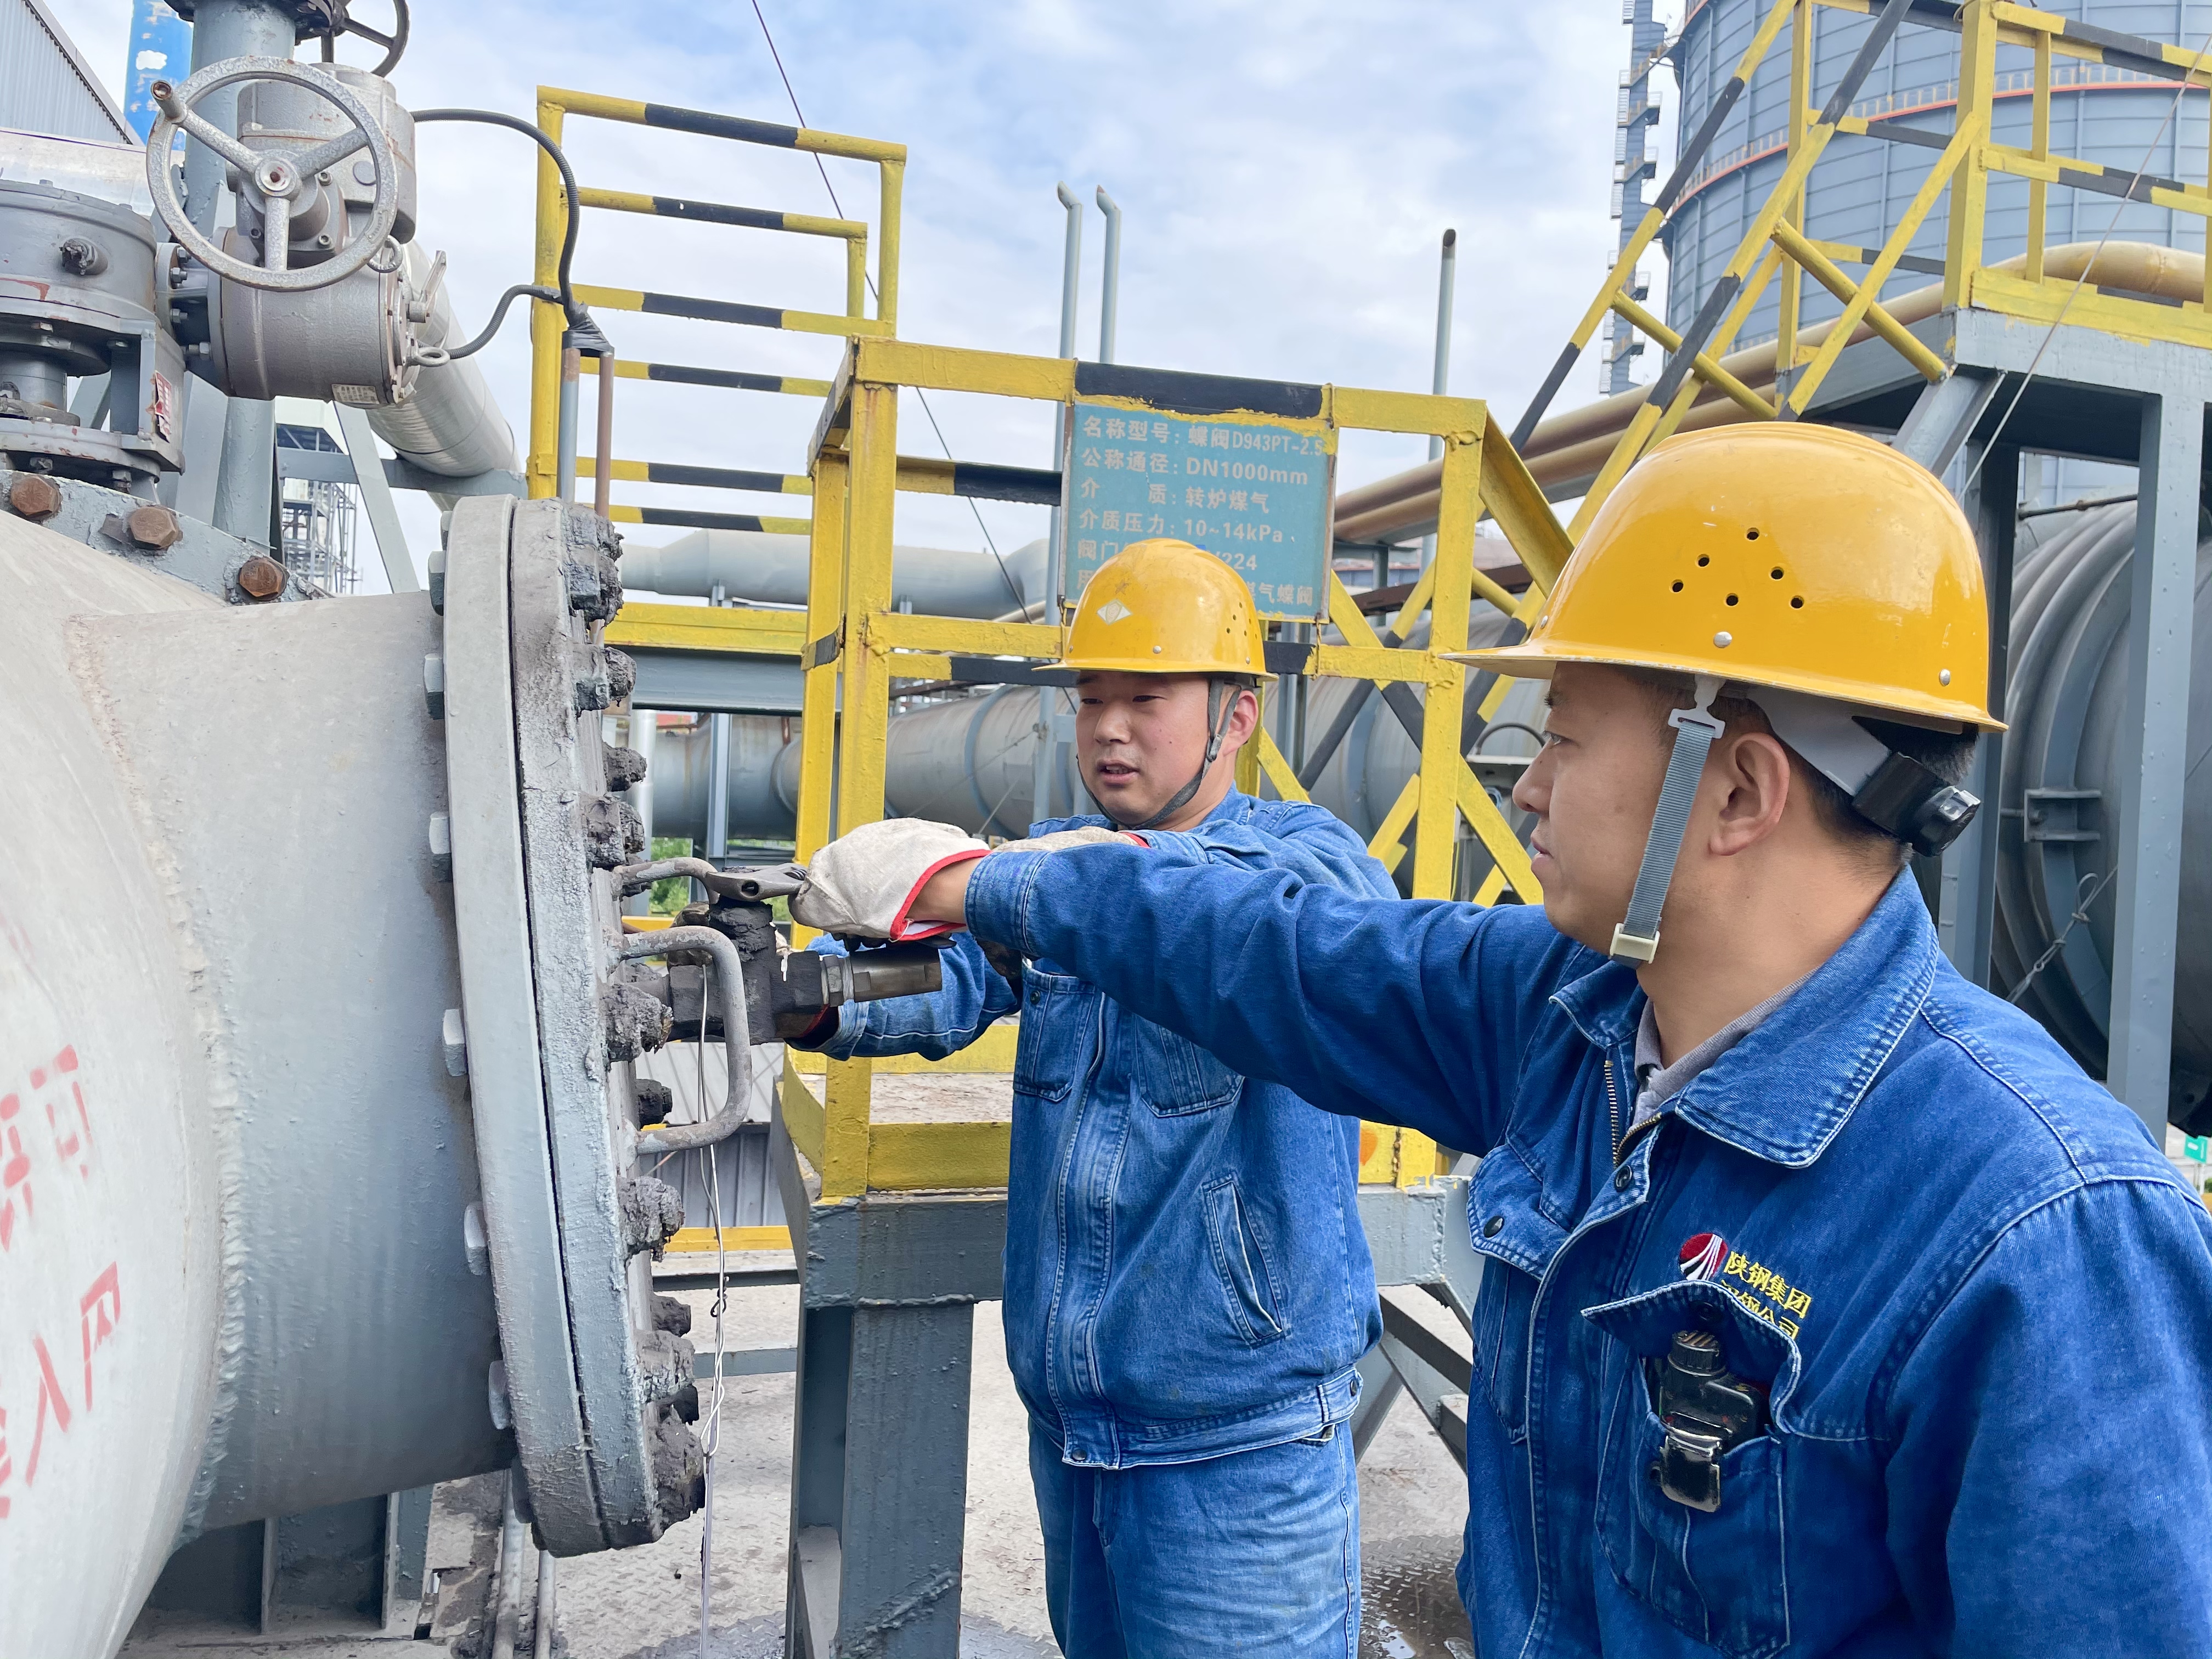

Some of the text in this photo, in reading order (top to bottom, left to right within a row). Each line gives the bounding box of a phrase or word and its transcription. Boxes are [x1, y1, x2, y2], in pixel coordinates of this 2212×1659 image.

[1081, 477, 1100, 499] 介
[1077, 538, 1257, 571] 阀门 224
